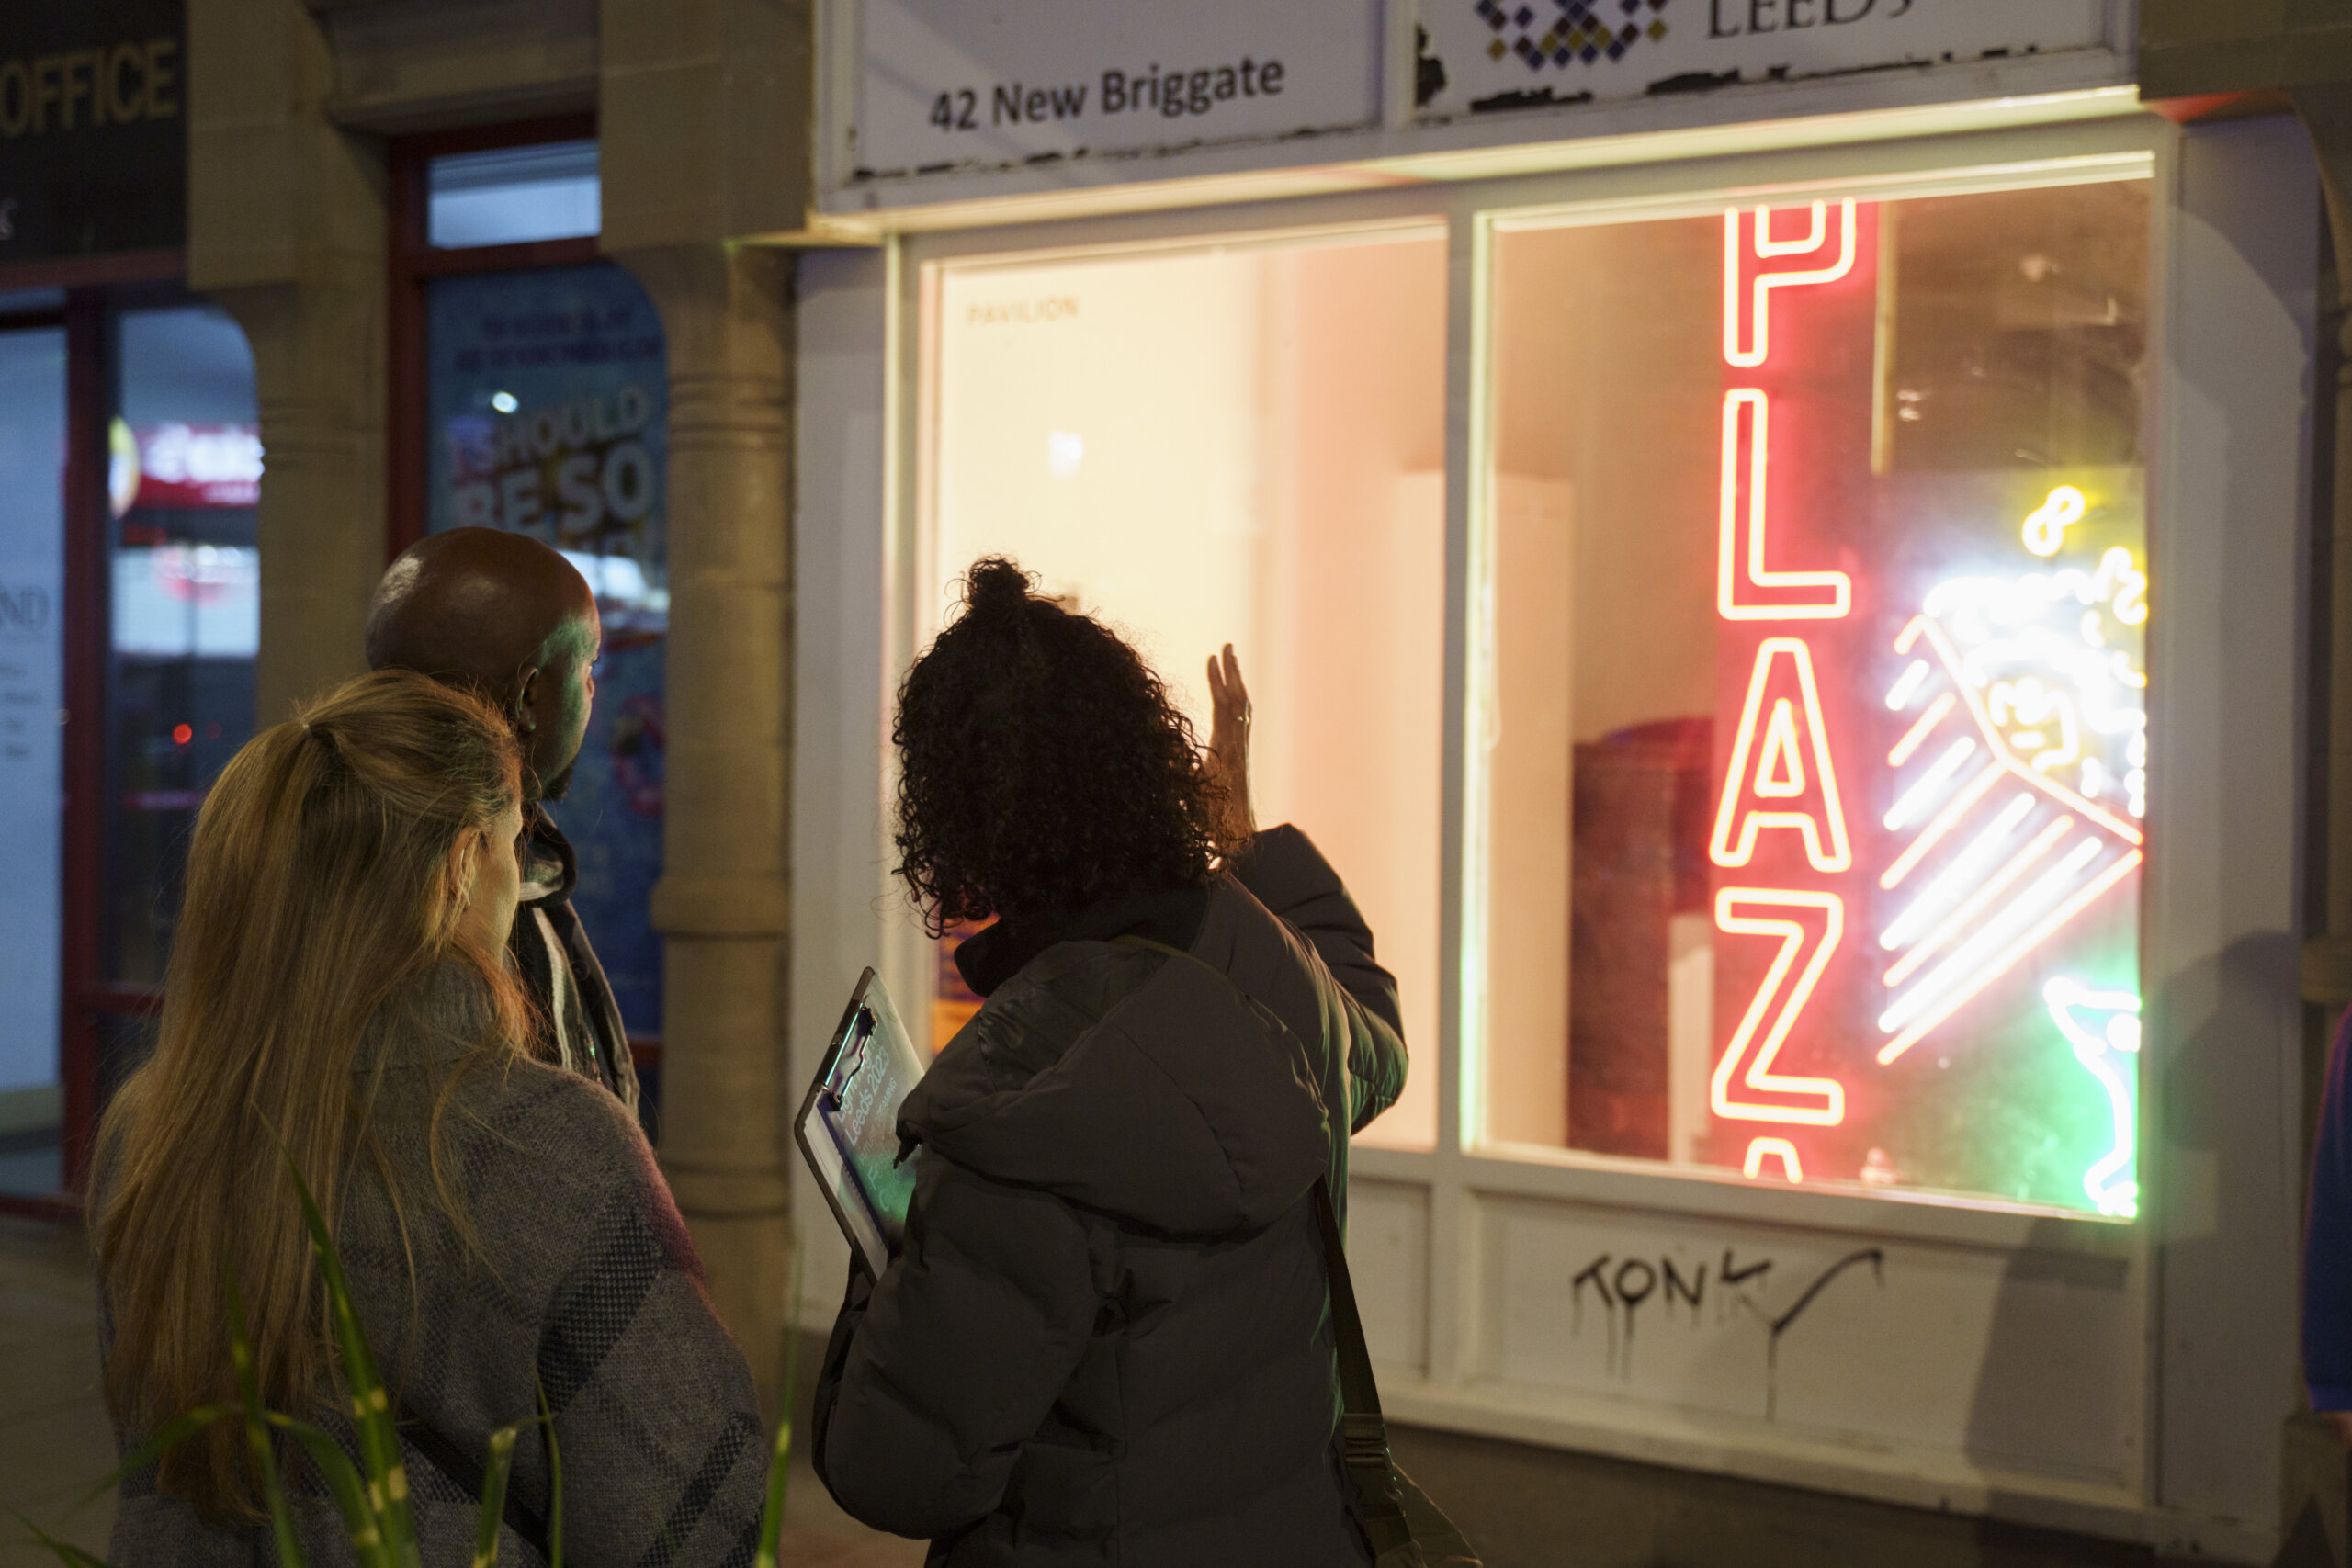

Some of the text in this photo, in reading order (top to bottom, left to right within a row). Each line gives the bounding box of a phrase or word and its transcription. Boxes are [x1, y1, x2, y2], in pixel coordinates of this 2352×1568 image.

[0, 39, 178, 137] OFFICE
[929, 55, 1285, 132] 42 New Briggate
[967, 294, 1080, 328] PAVILION
[558, 443, 654, 533] SO
[1711, 197, 1856, 1185] PLAZ
[844, 1087, 873, 1147] Leeds
[867, 1046, 890, 1095] 2023
